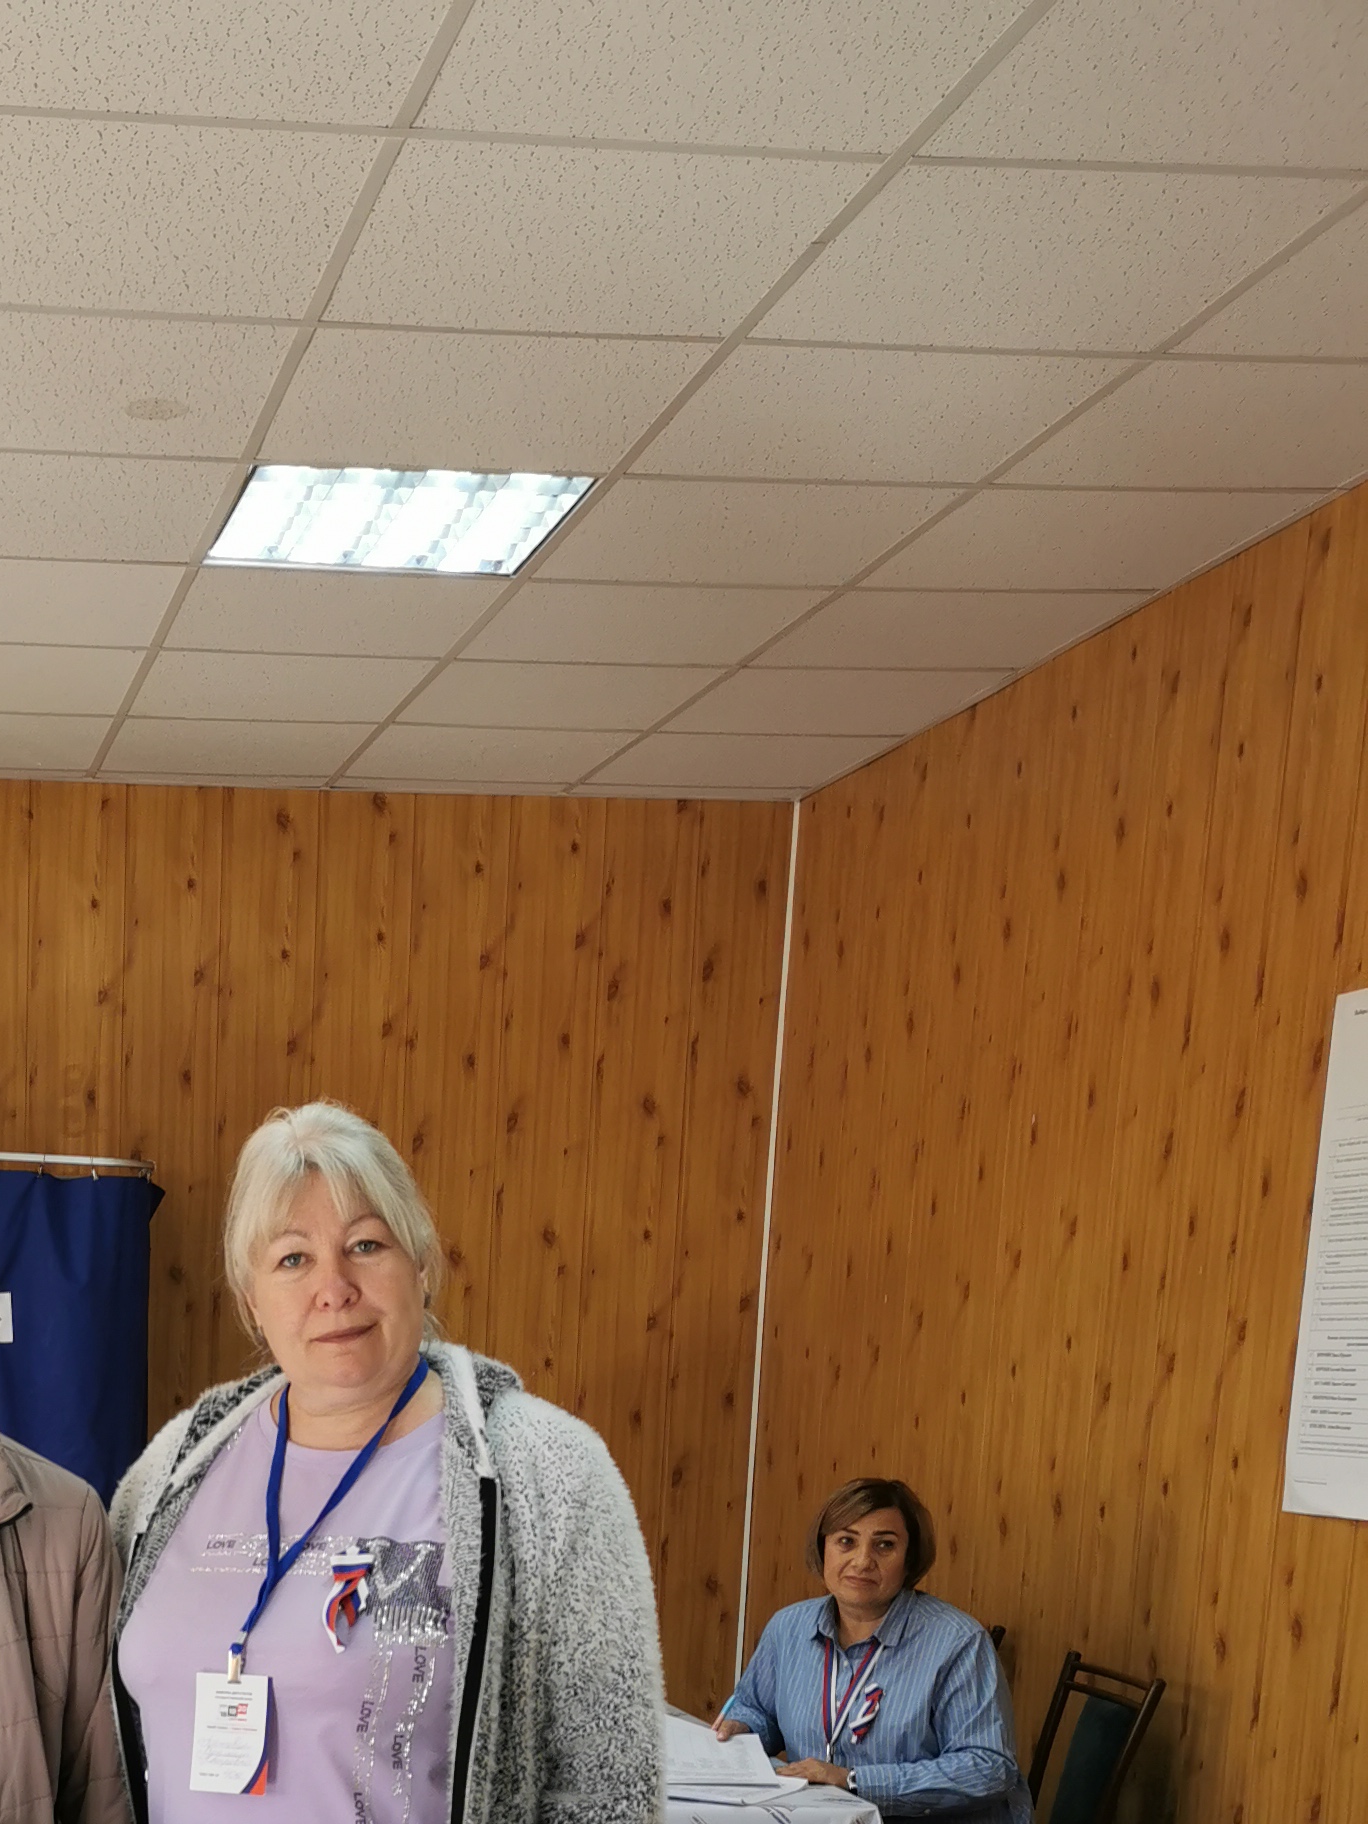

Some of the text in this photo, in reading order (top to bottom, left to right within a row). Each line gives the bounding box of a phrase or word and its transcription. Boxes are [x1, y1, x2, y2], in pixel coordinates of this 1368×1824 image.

[301, 1541, 327, 1551] OVE
[411, 1645, 427, 1683] LOVE
[356, 1700, 374, 1733] LOVE
[390, 1734, 404, 1770] LOVE
